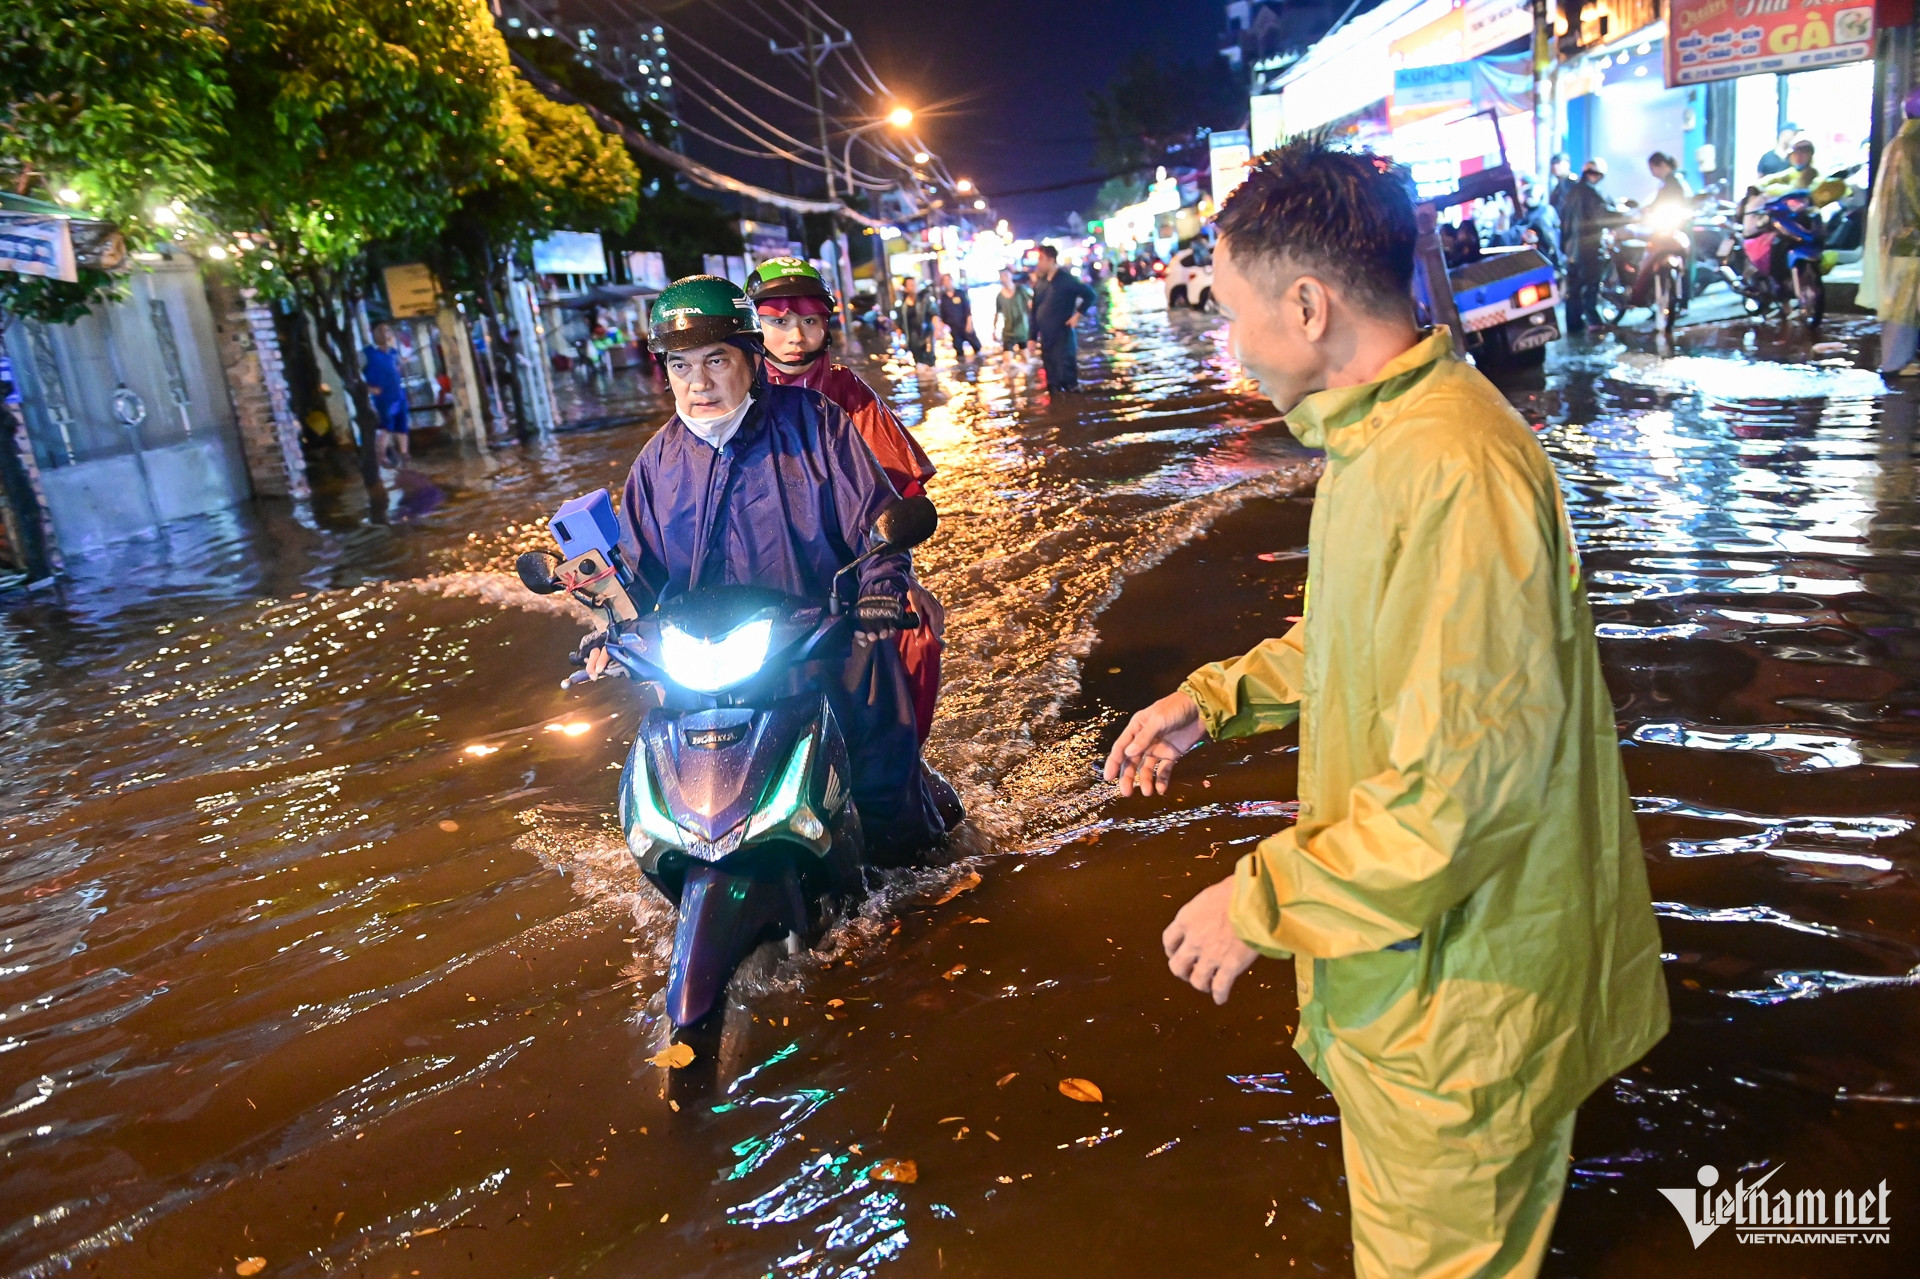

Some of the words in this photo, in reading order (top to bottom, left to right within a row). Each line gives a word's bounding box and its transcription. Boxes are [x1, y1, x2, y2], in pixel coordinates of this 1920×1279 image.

[1768, 11, 1831, 54] GÀ
[1400, 65, 1466, 82] KUMON
[781, 267, 804, 275] gojek
[662, 307, 702, 318] HONDA
